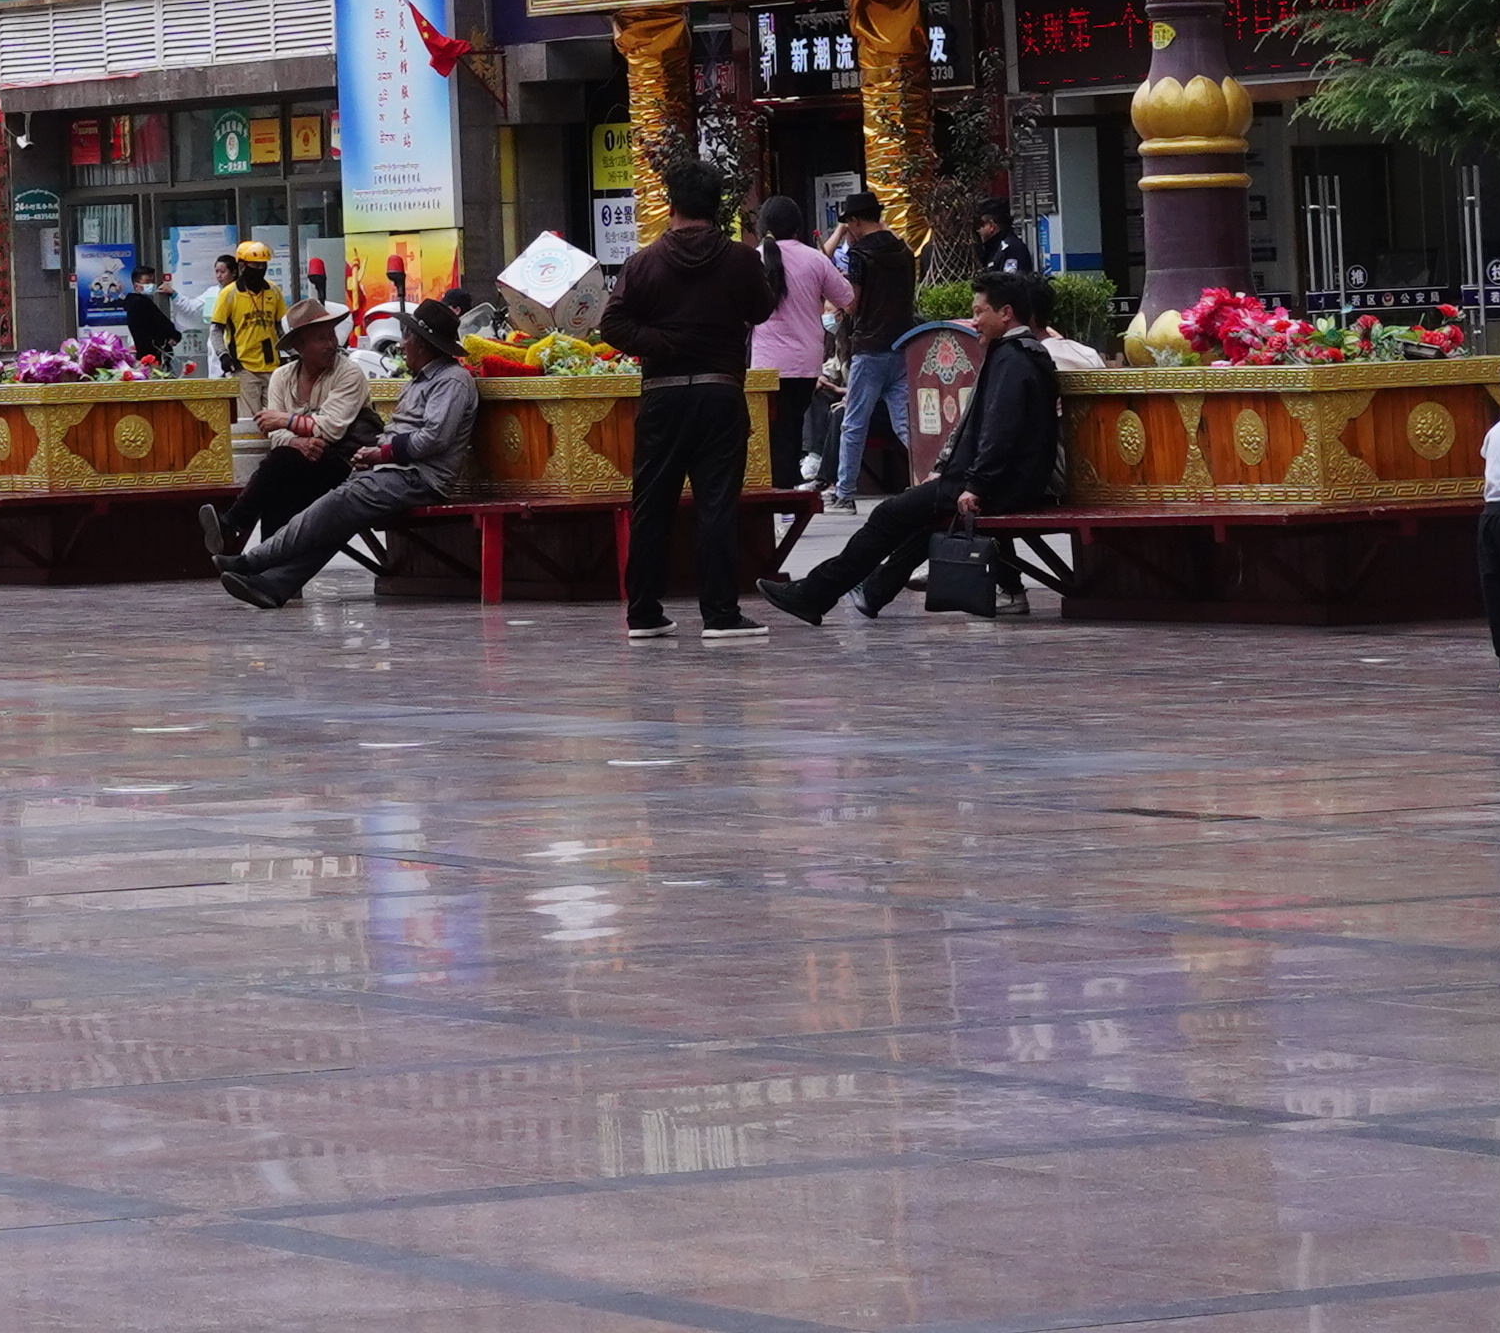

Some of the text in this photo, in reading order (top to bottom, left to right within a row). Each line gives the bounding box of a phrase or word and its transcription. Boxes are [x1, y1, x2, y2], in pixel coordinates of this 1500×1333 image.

[1350, 269, 1366, 286] 推
[1399, 290, 1441, 305] 公安局
